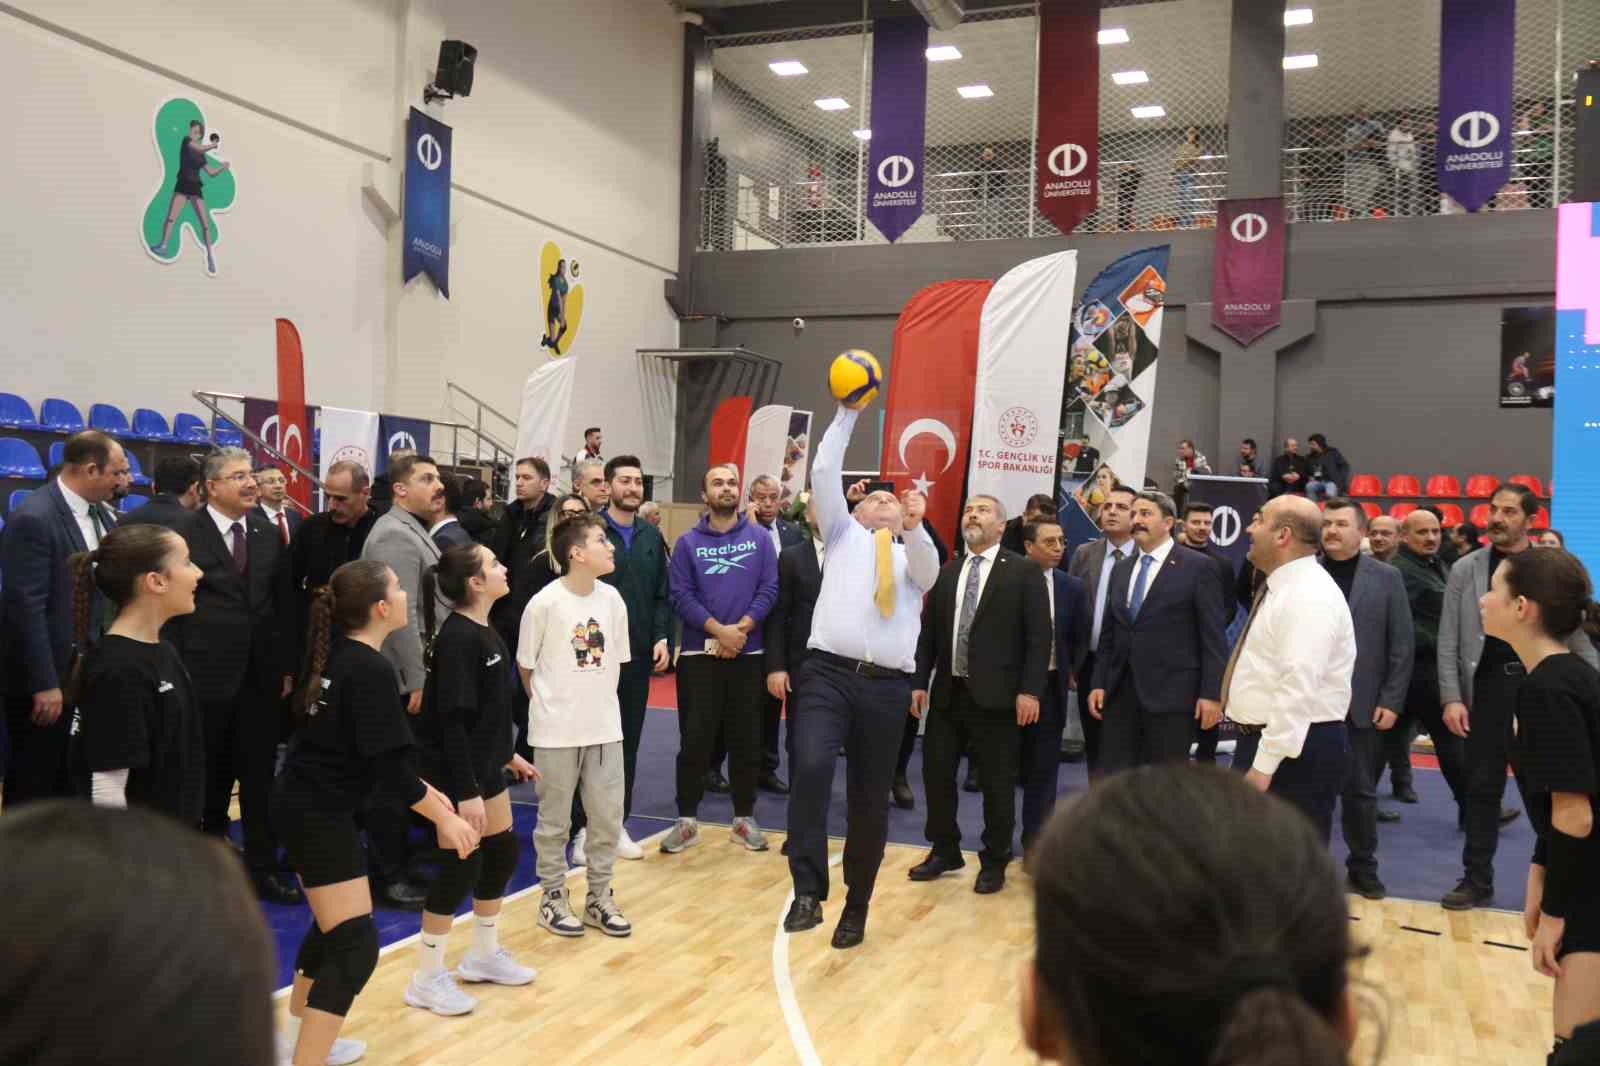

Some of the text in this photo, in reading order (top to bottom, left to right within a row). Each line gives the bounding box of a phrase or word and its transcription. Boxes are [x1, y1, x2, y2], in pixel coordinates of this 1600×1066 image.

[1446, 152, 1503, 162] ANADOLU
[1044, 180, 1091, 190] ANADOLU
[873, 191, 917, 200] ANADOLU
[1223, 303, 1272, 311] ANADOLU
[996, 451, 1039, 463] GENÇLİK
[1041, 455, 1055, 463] VE
[1002, 462, 1053, 474] BAKANLIĞI
[696, 540, 757, 557] Reebok
